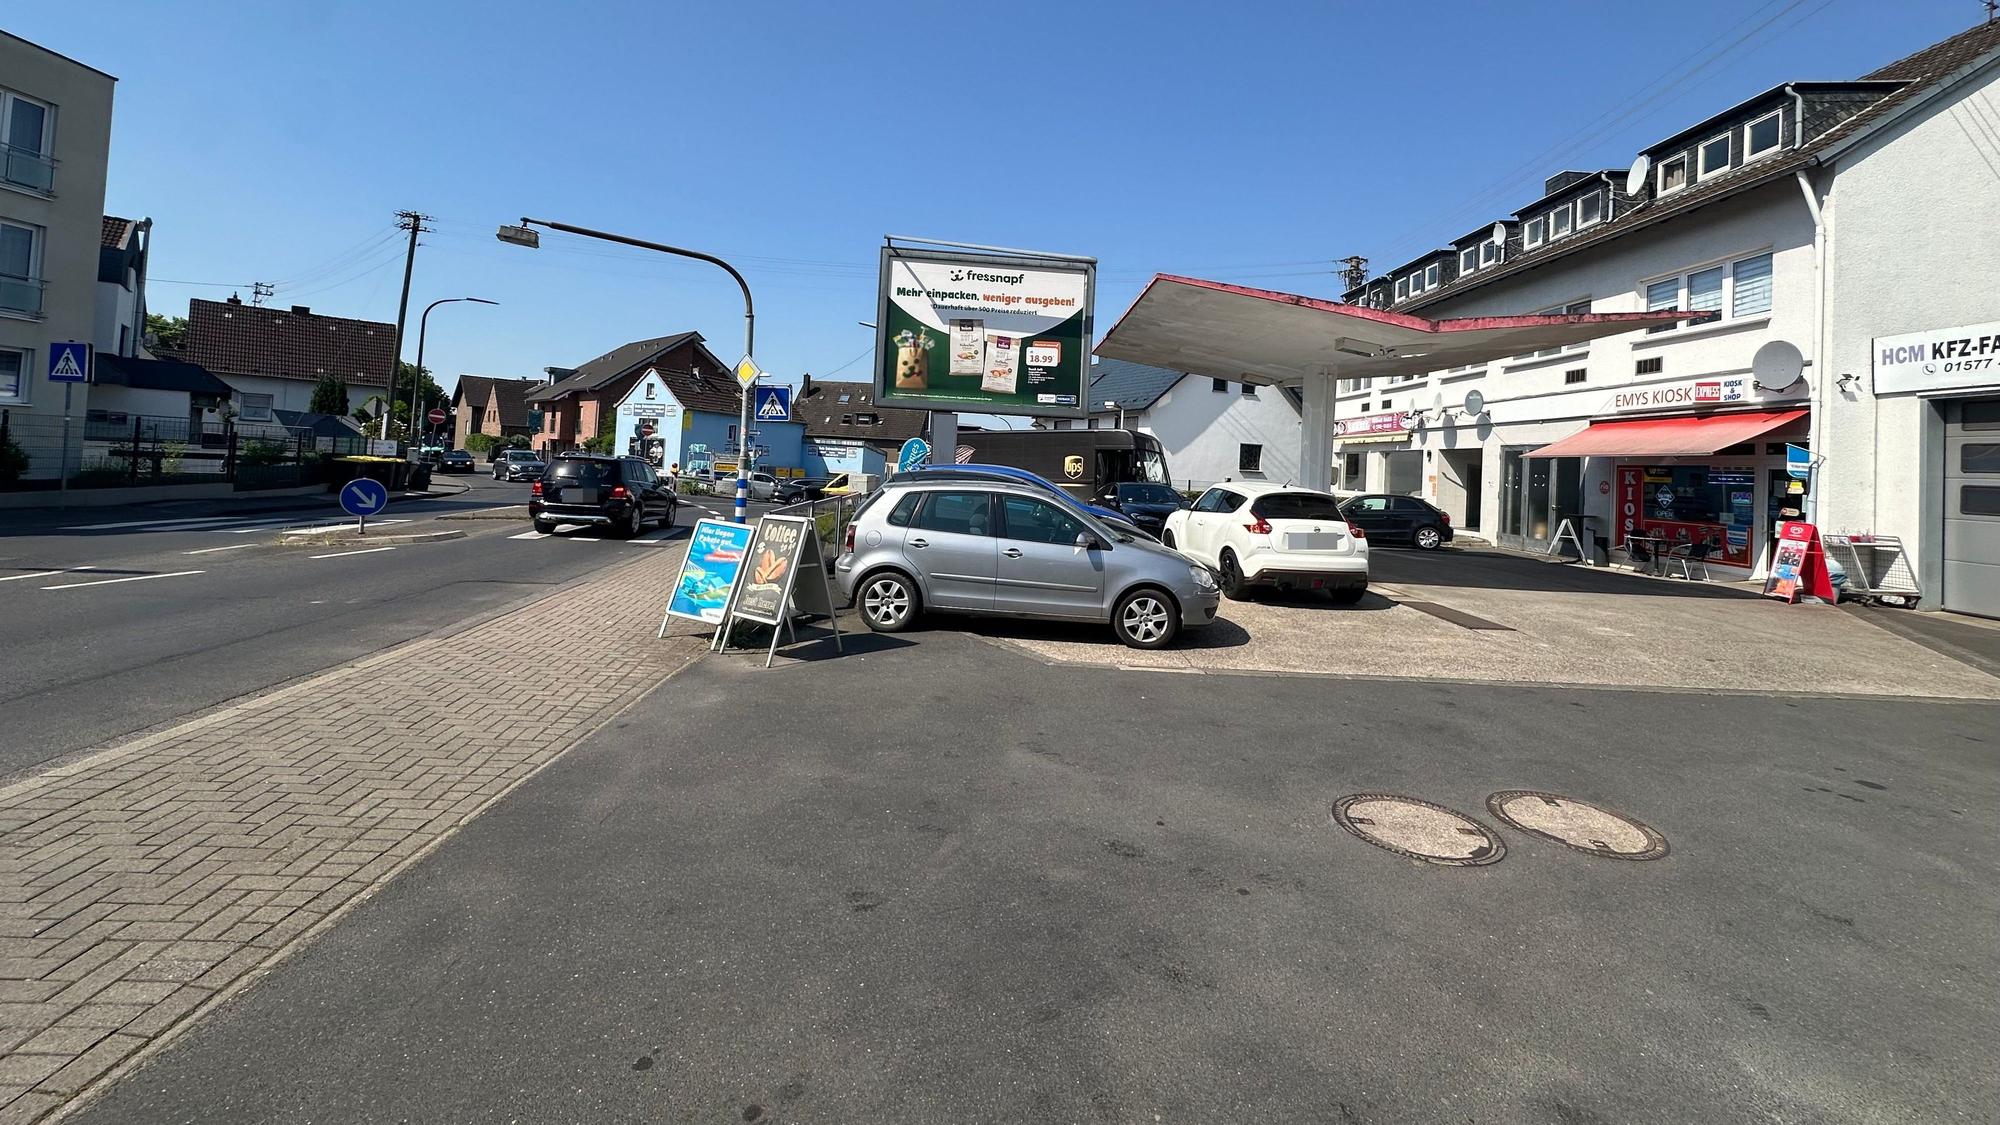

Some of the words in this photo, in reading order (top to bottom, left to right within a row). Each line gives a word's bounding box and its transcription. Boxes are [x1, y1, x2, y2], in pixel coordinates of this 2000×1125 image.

[966, 270, 1024, 285] fressnapf
[896, 287, 923, 297] Mehr
[926, 289, 980, 301] einpacken.
[983, 293, 1022, 305] weniger
[1025, 297, 1075, 307] ausgeben!
[1882, 344, 1925, 365] HCM
[1944, 359, 1993, 373] 01577
[1723, 380, 1742, 388] KIOSK
[1615, 391, 1649, 407] EMYS
[1652, 387, 1693, 404] KIOSK
[904, 442, 920, 471] ermes
[1066, 462, 1082, 475] ups
[1624, 471, 1637, 546] KIOS
[765, 523, 798, 543] Coffee
